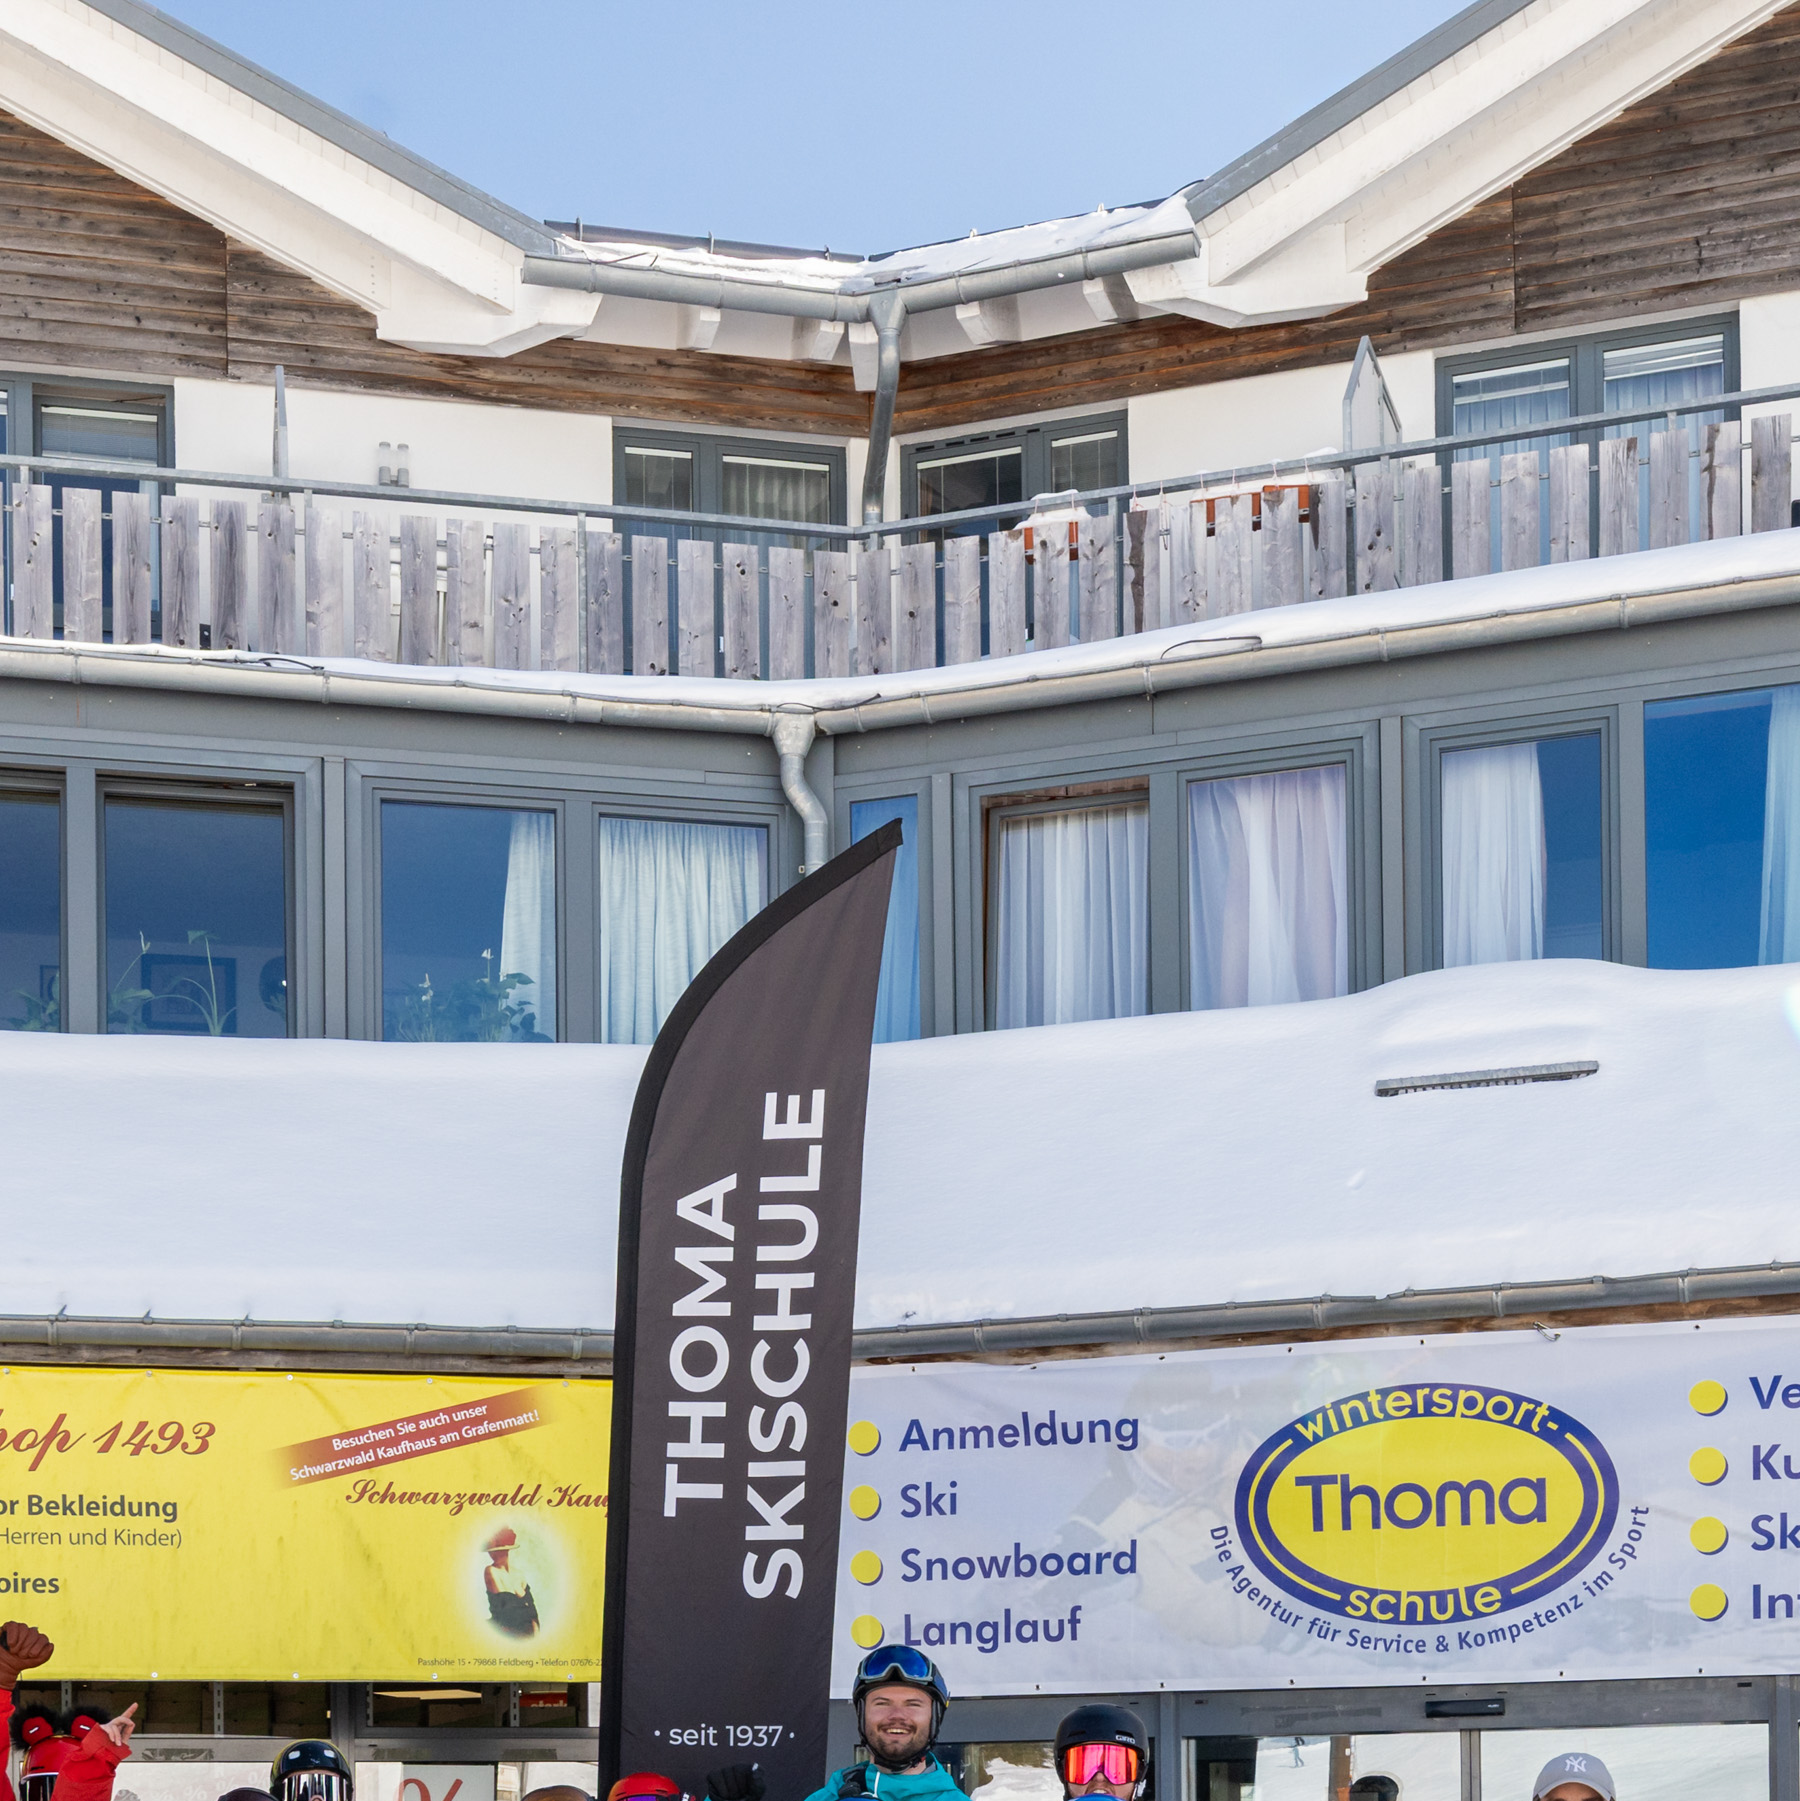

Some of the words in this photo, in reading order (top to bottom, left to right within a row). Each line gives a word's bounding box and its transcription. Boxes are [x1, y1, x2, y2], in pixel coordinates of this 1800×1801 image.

[664, 1173, 737, 1518] THOMA
[743, 1089, 825, 1600] SKISCHULE
[332, 1424, 395, 1451] Besuchen
[396, 1421, 417, 1437] Sie
[419, 1412, 450, 1431] auch
[452, 1404, 488, 1423] unser
[899, 1410, 1139, 1453] Anmeldung
[1294, 1387, 1559, 1443] wintersport-
[93, 1419, 216, 1458] 1493
[290, 1449, 375, 1481] Schwarzwald
[376, 1437, 437, 1460] Kaufhaus
[439, 1431, 460, 1444] am
[462, 1409, 540, 1439] Grafenmatt!
[27, 1494, 178, 1523] Bekleidung
[346, 1479, 543, 1516] Schwarzwald
[546, 1484, 609, 1518] Kau
[900, 1481, 958, 1518] Ski
[1294, 1473, 1547, 1533] Thoma
[69, 1528, 107, 1546] und
[114, 1528, 182, 1549] Kinder)
[901, 1539, 1138, 1584] Snowboard
[1209, 1525, 1233, 1563] Die
[1226, 1558, 1304, 1628] Agentur
[1308, 1616, 1341, 1643] für
[1345, 1627, 1427, 1654] Service
[1435, 1635, 1450, 1653] &
[1458, 1594, 1585, 1651] Kompetenz
[1581, 1568, 1615, 1598] im
[1608, 1505, 1650, 1571] Sport
[1345, 1585, 1502, 1622] schule
[904, 1605, 1082, 1655] Langlauf
[418, 1657, 455, 1666] Passhöhe
[457, 1658, 466, 1666] 15
[473, 1658, 496, 1666] 79868
[499, 1658, 534, 1668] Feldberg
[541, 1658, 569, 1666] Telefon
[669, 1725, 718, 1747] seit
[725, 1725, 783, 1747] 1937
[1115, 1734, 1136, 1744] GIRO
